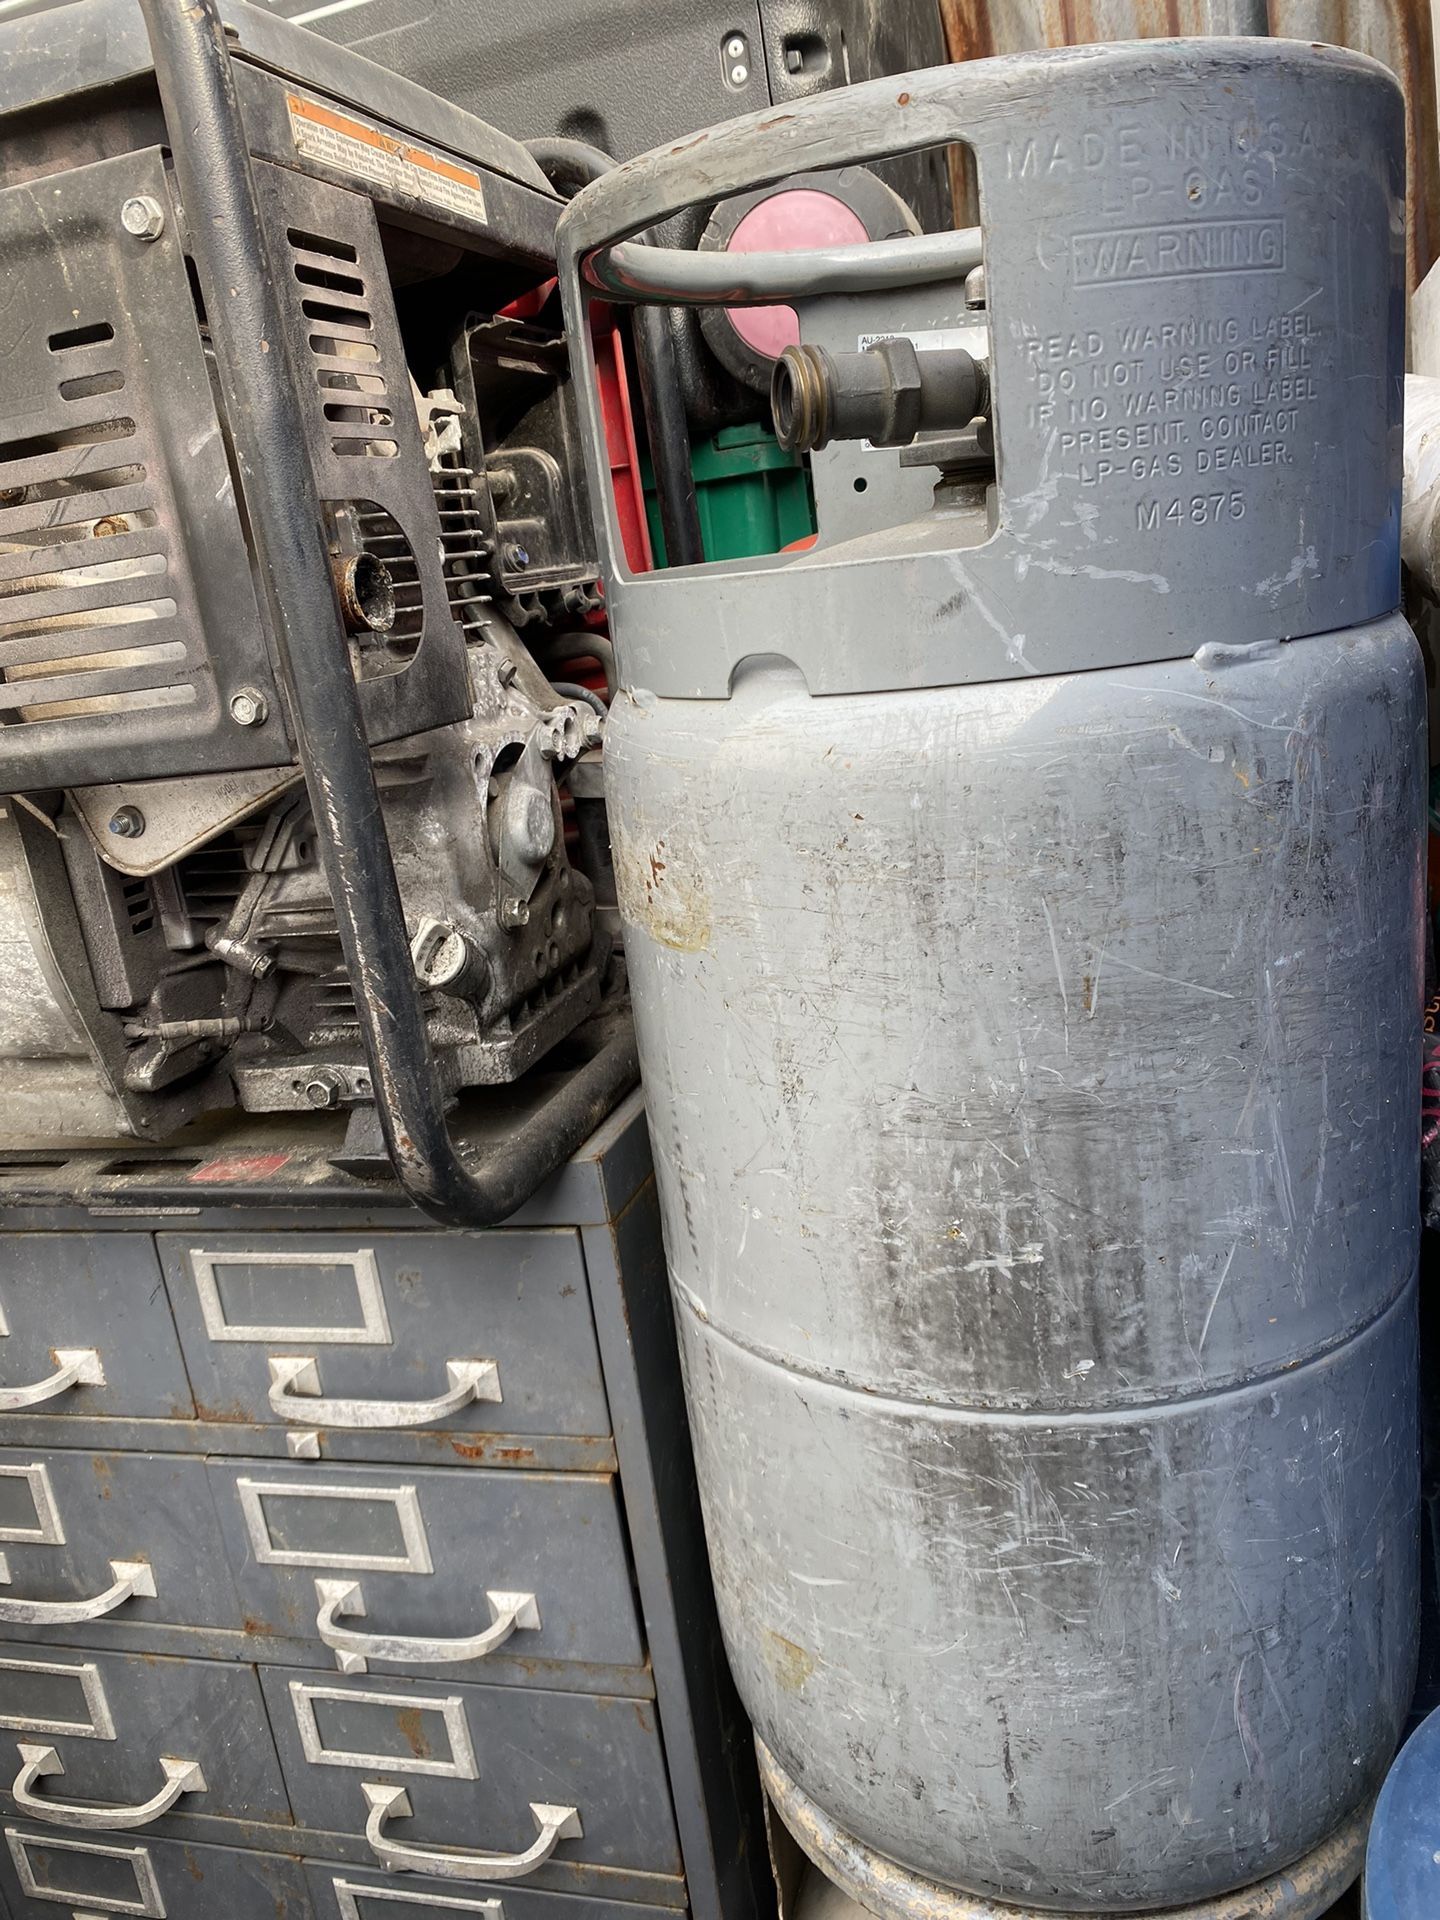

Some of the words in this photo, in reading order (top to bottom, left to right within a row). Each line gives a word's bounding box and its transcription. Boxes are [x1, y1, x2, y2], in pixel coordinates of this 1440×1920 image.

[1006, 123, 1143, 180] MADE
[1168, 121, 1209, 162] IN
[1102, 168, 1264, 218] LP-GAS
[1086, 228, 1279, 278] WARNING
[1027, 331, 1104, 364] READ
[1118, 317, 1240, 352] WARNING
[1037, 367, 1077, 397] DO
[1092, 360, 1145, 389] NOT
[1160, 352, 1213, 382] USE
[1224, 349, 1257, 376] OR
[1265, 345, 1313, 373] FILL
[1028, 399, 1056, 429] IF
[1068, 397, 1108, 425] NO
[1122, 382, 1242, 418] WARNING
[1252, 375, 1318, 406] LABEL
[1060, 419, 1190, 457] PRESENT.
[1200, 408, 1300, 442] CONTACT
[1079, 452, 1185, 488] LP-GAS
[1196, 440, 1294, 475] DEALER.
[1135, 490, 1247, 532] M4875
